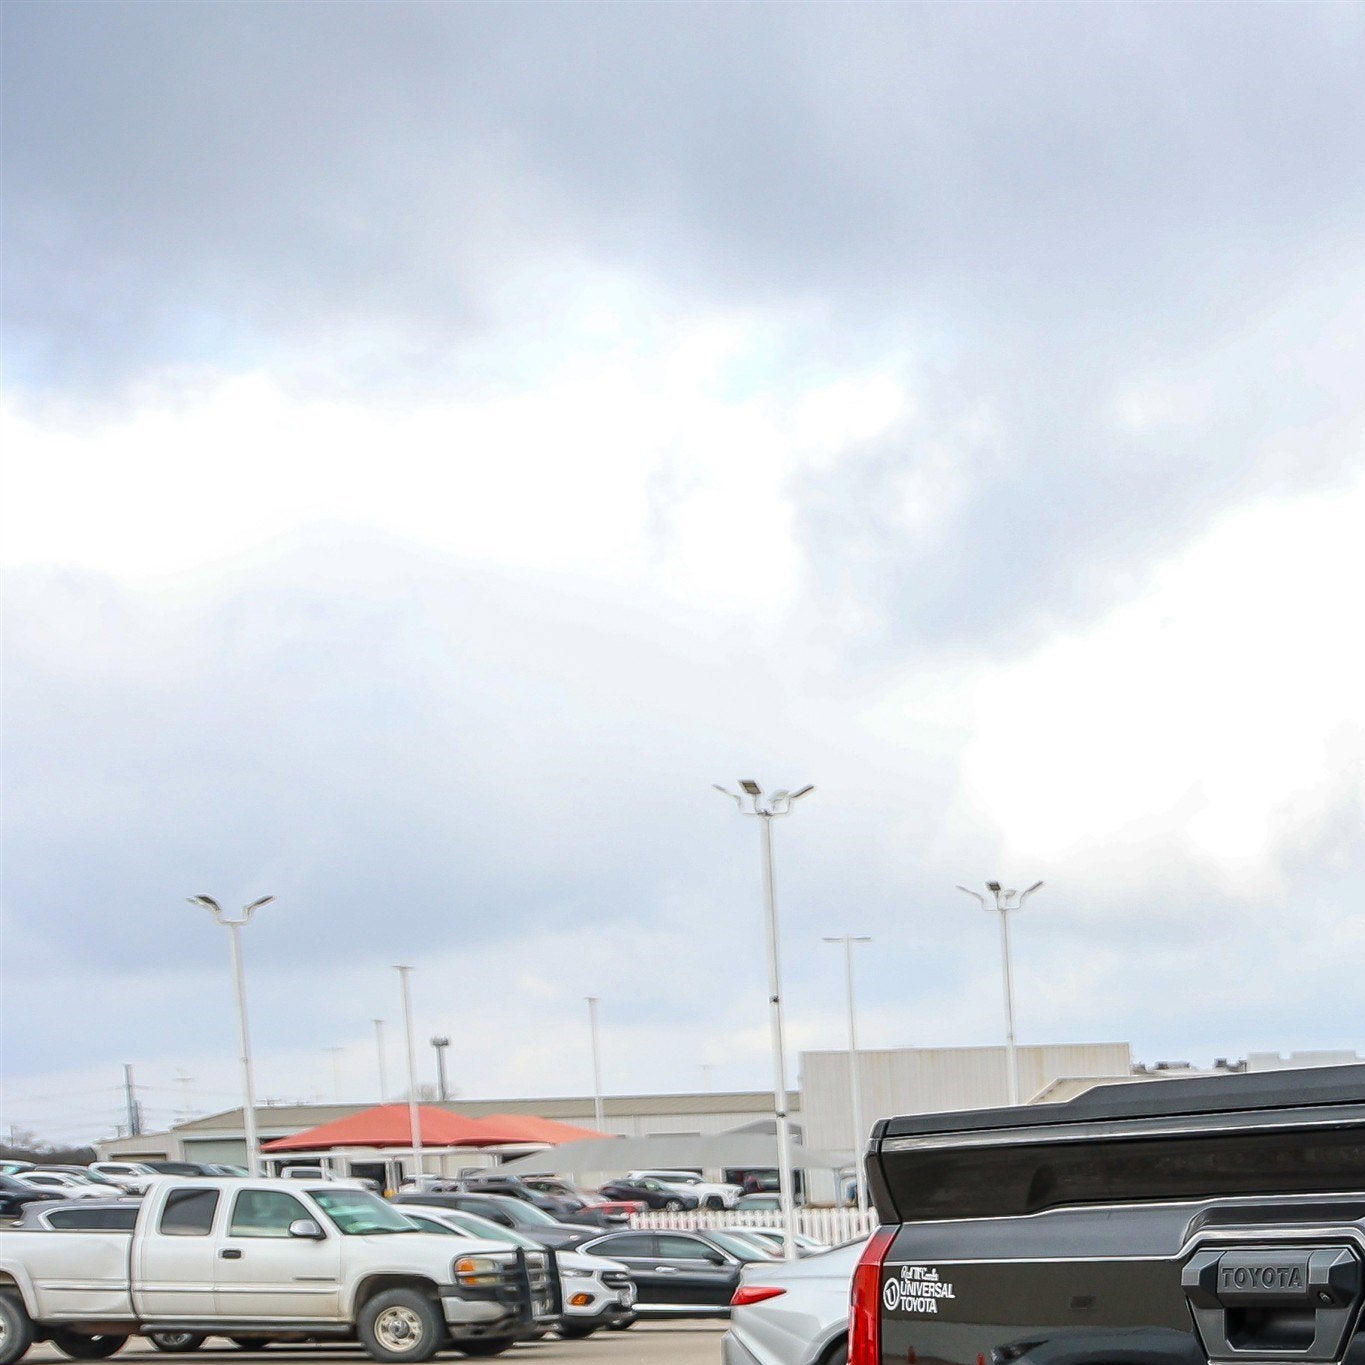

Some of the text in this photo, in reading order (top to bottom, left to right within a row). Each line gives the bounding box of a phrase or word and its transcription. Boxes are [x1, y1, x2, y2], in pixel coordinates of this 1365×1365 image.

[1221, 1266, 1303, 1289] TOYOTA
[900, 1281, 955, 1298] UNIVERSAL
[900, 1297, 937, 1313] TOYOTA
